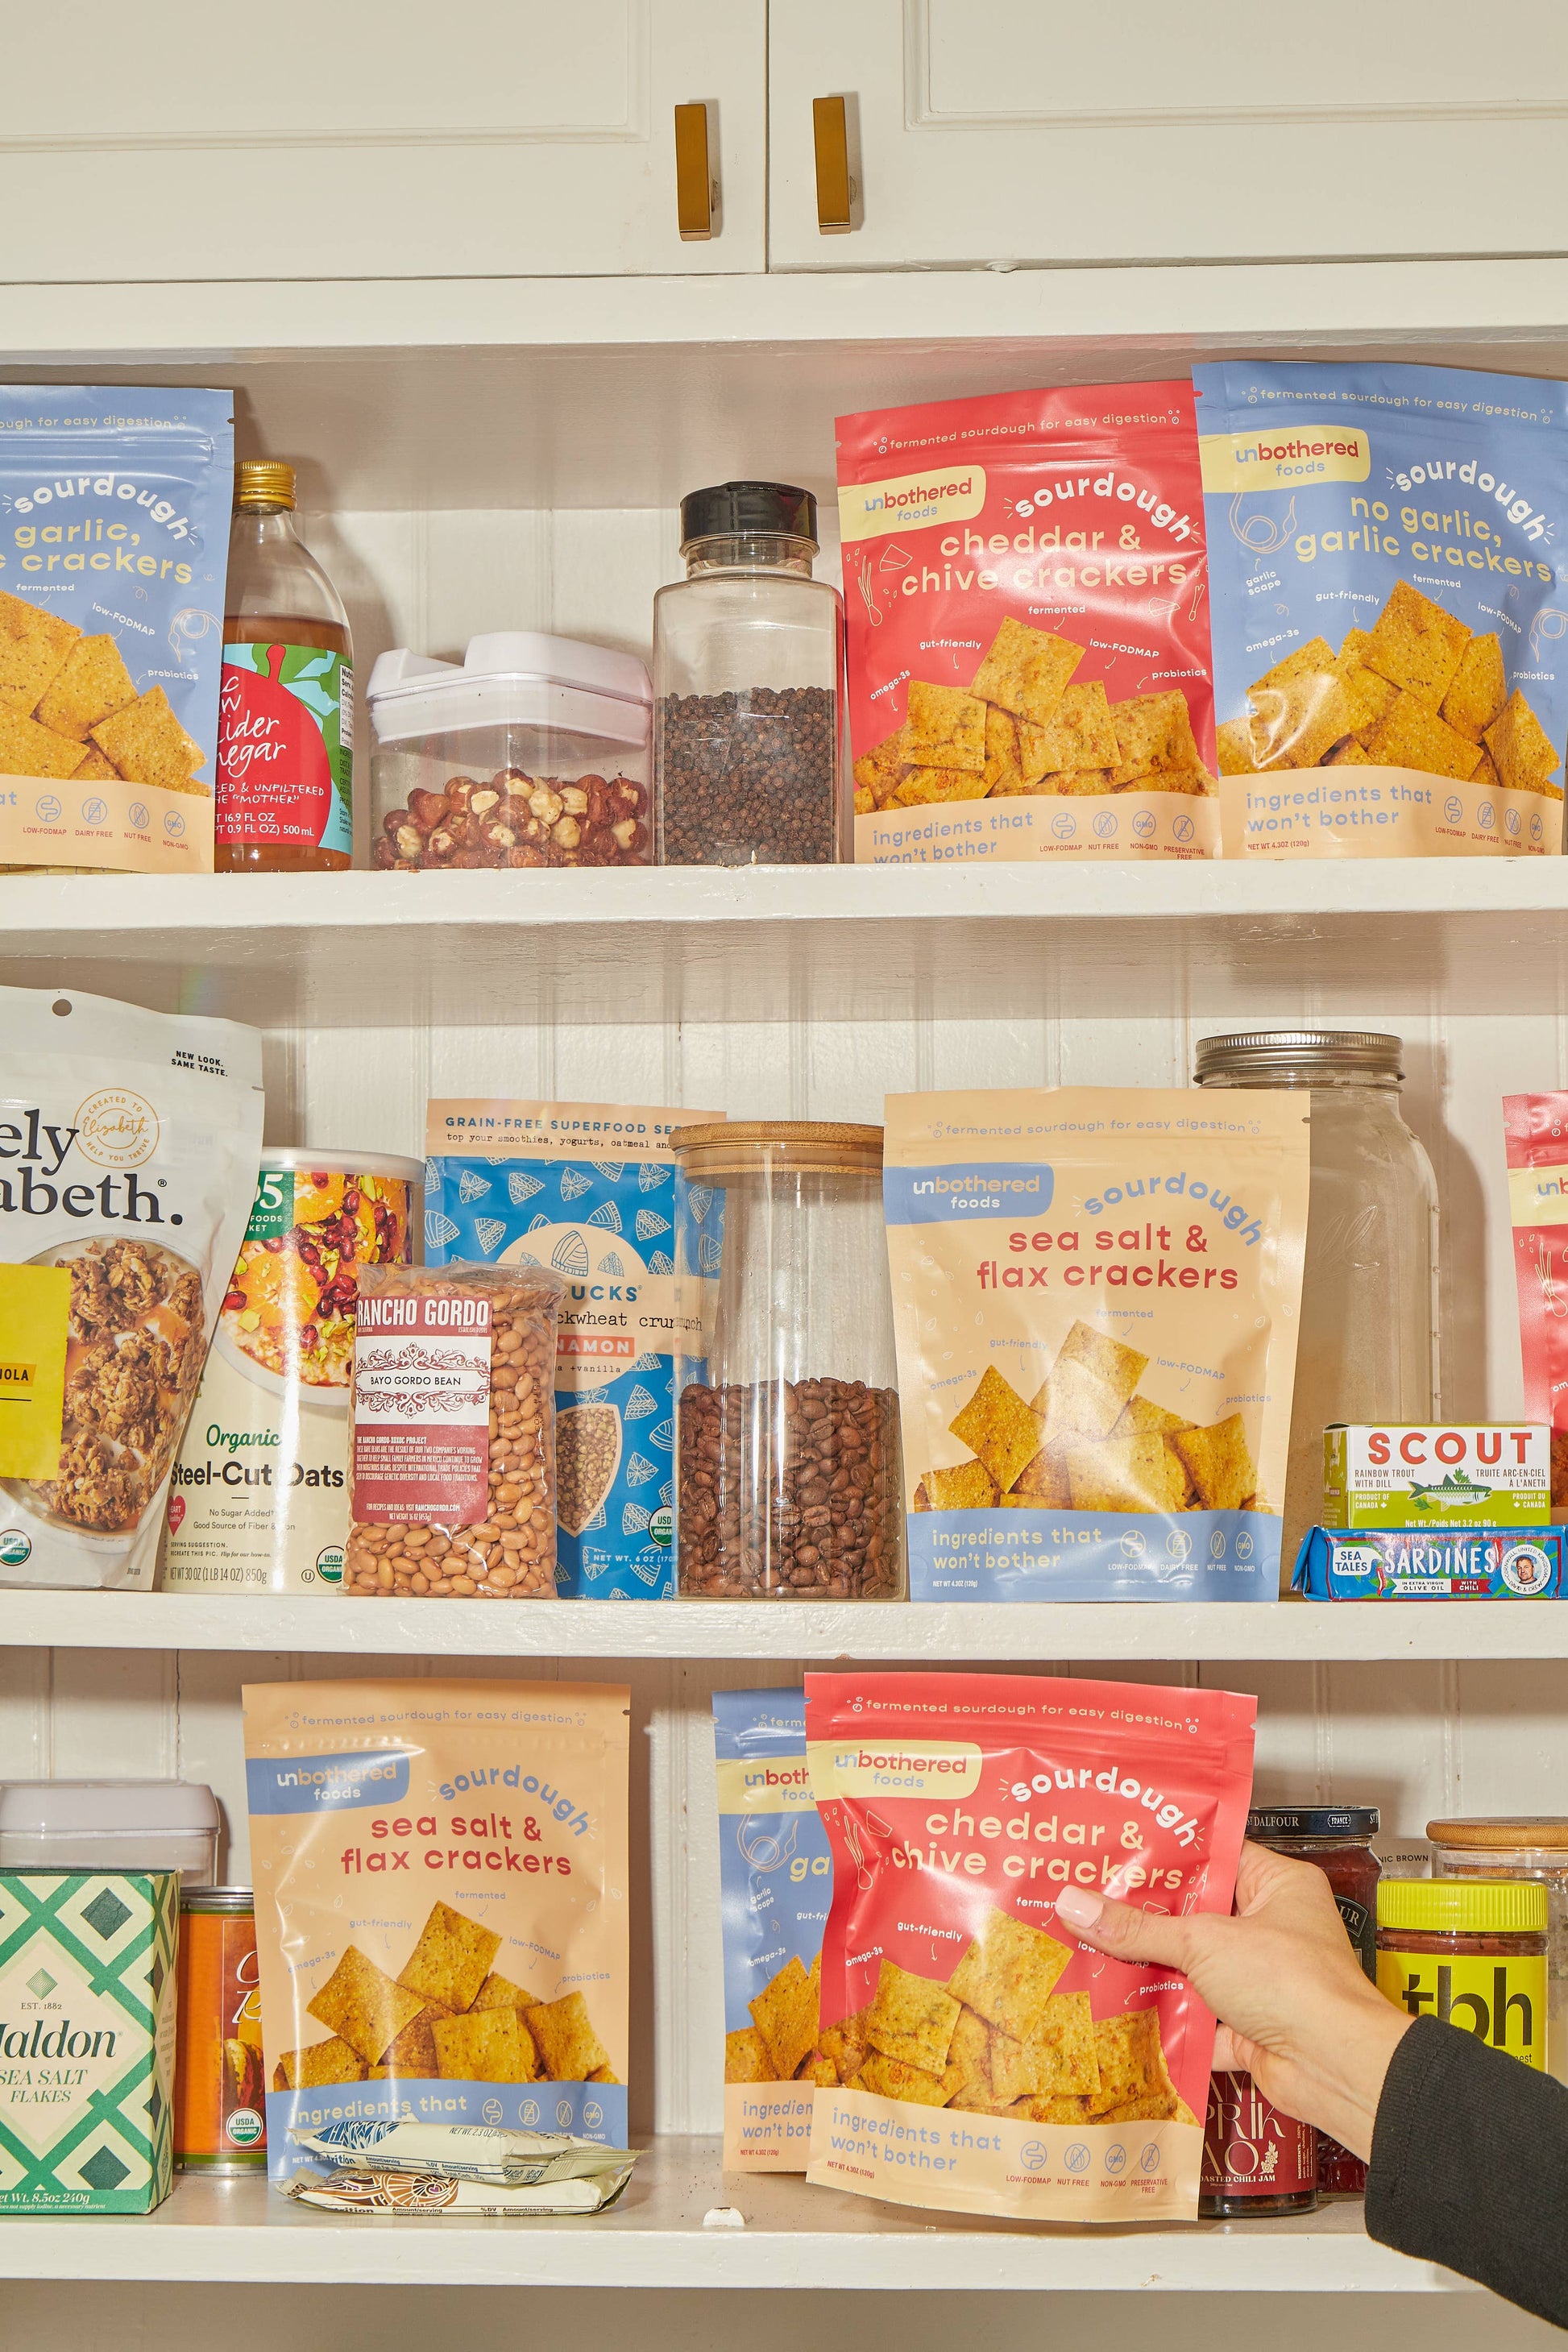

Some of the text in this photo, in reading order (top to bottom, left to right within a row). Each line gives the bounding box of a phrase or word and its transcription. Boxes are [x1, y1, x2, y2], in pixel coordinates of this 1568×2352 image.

[890, 414, 1167, 449] fermented sourdough for easy digestion
[1236, 442, 1359, 463] unbothered
[1276, 462, 1325, 476] foods
[865, 478, 972, 512] unbothered
[1396, 460, 1545, 541] sourdough
[14, 474, 189, 541] sourdough
[897, 505, 938, 521] foods
[1014, 472, 1191, 541] sourdough
[1351, 497, 1502, 548] no garlic,
[14, 519, 141, 548] garlic,
[940, 525, 1140, 557] cheddar &
[1295, 526, 1552, 583] garlic crackers
[22, 547, 193, 584] crackers
[902, 559, 1187, 596] chive crackers
[1246, 570, 1276, 587] garlic
[1412, 574, 1461, 588] fermented
[15, 583, 75, 592] fermented
[1248, 580, 1281, 595] scape
[1316, 591, 1379, 605] gut-friendly
[91, 602, 156, 637] low-FODMAP
[1028, 606, 1085, 615] fermented
[1478, 602, 1521, 633] low-FODMAP
[919, 640, 981, 650] gut-friendly
[1089, 638, 1159, 657] low-FODMAP
[1246, 629, 1300, 652] omega-3s
[147, 668, 199, 680] probiotics
[1151, 668, 1207, 680] probiotics
[1513, 671, 1555, 680] probiotics
[869, 670, 911, 700] omega-3s
[255, 784, 324, 796] UNFILTERED
[1247, 786, 1432, 811] ingredients that
[873, 812, 1033, 848] ingredients that
[1248, 811, 1399, 832] won't bother
[1040, 844, 1082, 852] LOW-FODMAP
[1130, 843, 1158, 852] NON-GMO
[172, 1059, 228, 1076] SAME TASTE.
[176, 1051, 223, 1067] NEW LOOK.
[88, 1097, 142, 1114] CREATED TO
[82, 1116, 149, 1138] Elizabeth
[446, 1117, 645, 1133] GRAIN-FREE SUPERFOOD
[86, 1141, 103, 1157] HELP
[128, 1138, 150, 1160] THRIVE
[447, 1133, 649, 1148] top your smoothies, yogurts, oatmeal
[913, 1176, 1040, 1195] unbothered
[950, 1197, 1000, 1209] foods
[1085, 1172, 1263, 1247] sourdough
[1009, 1223, 1208, 1253] sea salt &
[977, 1259, 1238, 1290] flax crackers
[358, 1299, 488, 1327] RANCHO GORDO
[371, 1376, 461, 1385] BAYO GORDO BEAN
[206, 1424, 281, 1453] Organic
[1368, 1432, 1532, 1465] SCOUT
[172, 1461, 272, 1486] Steel-Cut
[1355, 1469, 1415, 1478] RAINBOW TROUT
[1476, 1469, 1545, 1478] TRUITE ARC-EN-CIEL
[1509, 1478, 1545, 1487] À L'ANETH
[1355, 1479, 1392, 1487] WITH DILL
[221, 1509, 242, 1519] Sugar
[248, 1522, 268, 1530] Fiber
[932, 1529, 1102, 1549] ingredients that
[933, 1552, 1060, 1569] won't bother
[1341, 1551, 1361, 1561] SEA
[1385, 1548, 1495, 1574] SARDINES
[1335, 1562, 1367, 1571] TALES
[836, 1749, 967, 1773] unbothered
[276, 1764, 396, 1787] unbothered
[873, 1773, 924, 1789] foods
[313, 1787, 361, 1801] foods
[438, 1765, 589, 1836] sourdough
[1010, 1766, 1199, 1847] sourdough
[371, 1813, 542, 1842] sea salt &
[926, 1807, 1143, 1851] cheddar &
[1255, 1817, 1299, 1827] DALFOUR
[342, 1847, 572, 1876] flax crackers
[892, 1841, 1184, 1889] chive crackers
[455, 1891, 506, 1901] fermented
[562, 1972, 611, 1984] probiotics
[44, 2002, 62, 2010] 1882
[0, 2069, 88, 2085] SEA SALT
[10, 2090, 71, 2103] FLAKES
[420, 2096, 467, 2112] that
[236, 2118, 255, 2126] USDA
[833, 2107, 1002, 2151] ingredients that
[830, 2134, 956, 2171] won't bother
[63, 2193, 89, 2205] 240g
